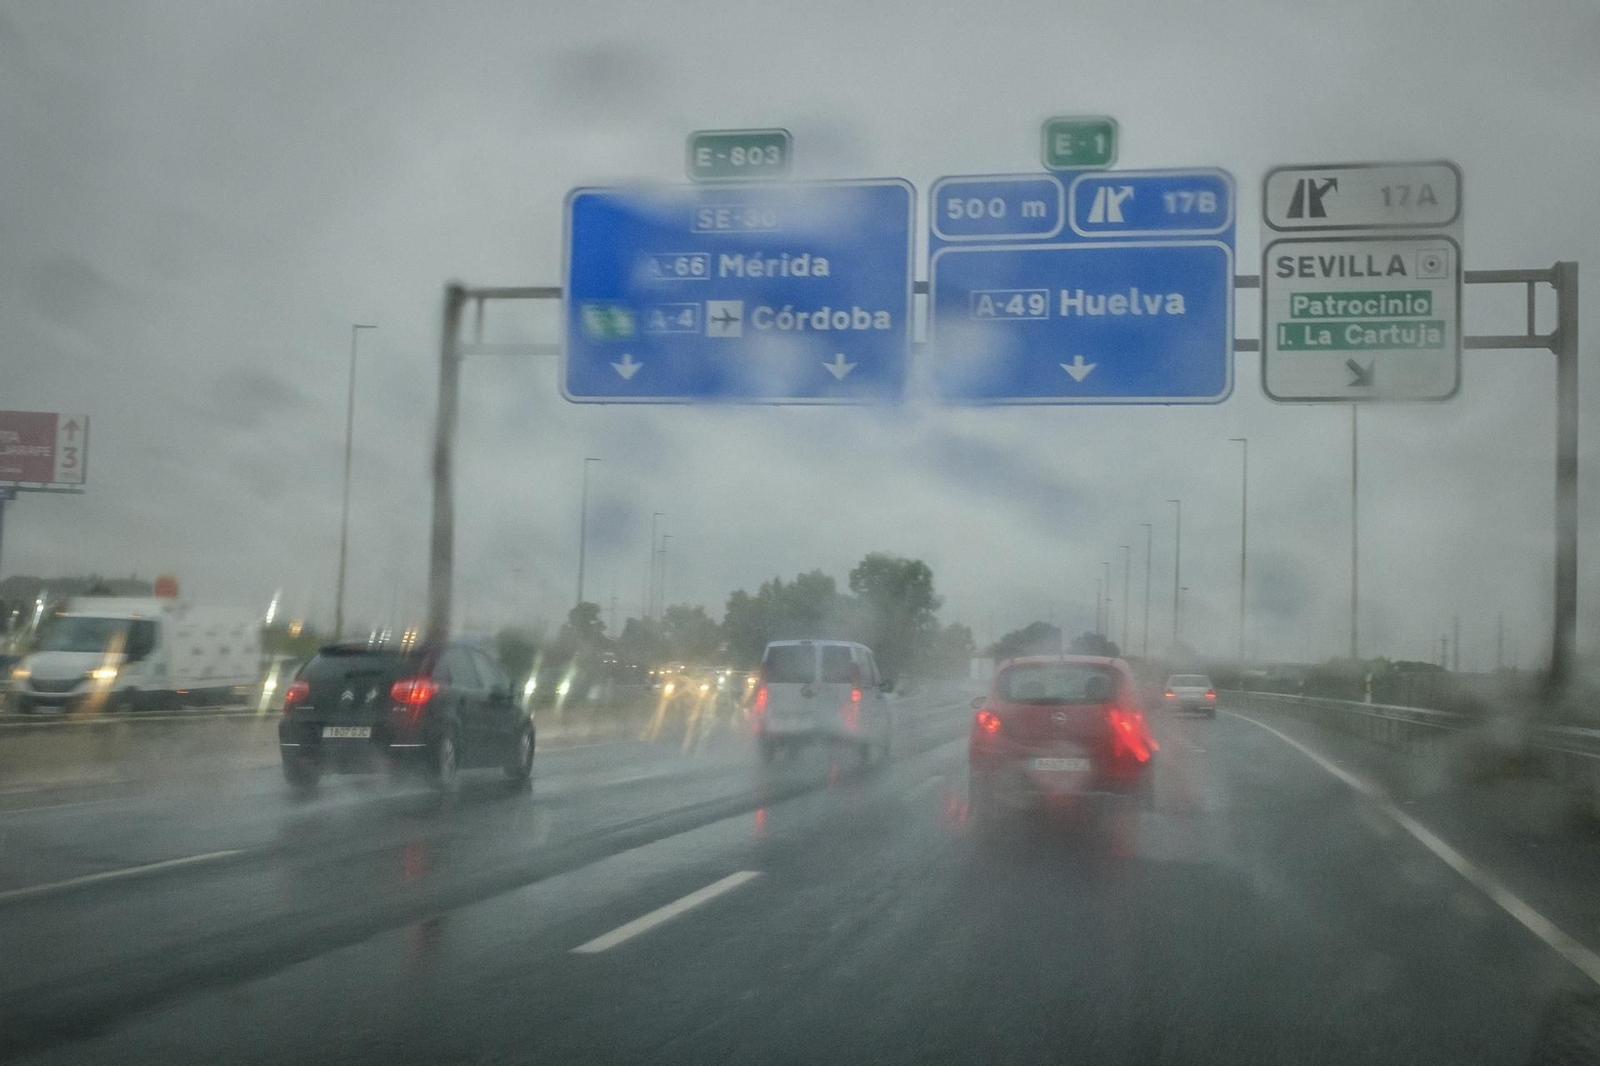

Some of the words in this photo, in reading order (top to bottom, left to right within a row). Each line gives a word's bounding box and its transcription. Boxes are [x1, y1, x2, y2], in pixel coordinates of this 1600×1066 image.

[1163, 191, 1217, 214] 17B
[1381, 183, 1438, 207] 17A
[947, 198, 1006, 219] 500
[1021, 199, 1047, 218] m
[718, 252, 831, 278] Mérida
[1275, 254, 1408, 278] SEVILLA
[975, 293, 1045, 317] A-49
[1060, 287, 1186, 316] Huelva
[1293, 293, 1430, 316] Patrocinio
[752, 304, 891, 330] Córdoba
[1305, 325, 1332, 345] La
[1345, 323, 1441, 346] Cartuja
[62, 446, 79, 468] 3
